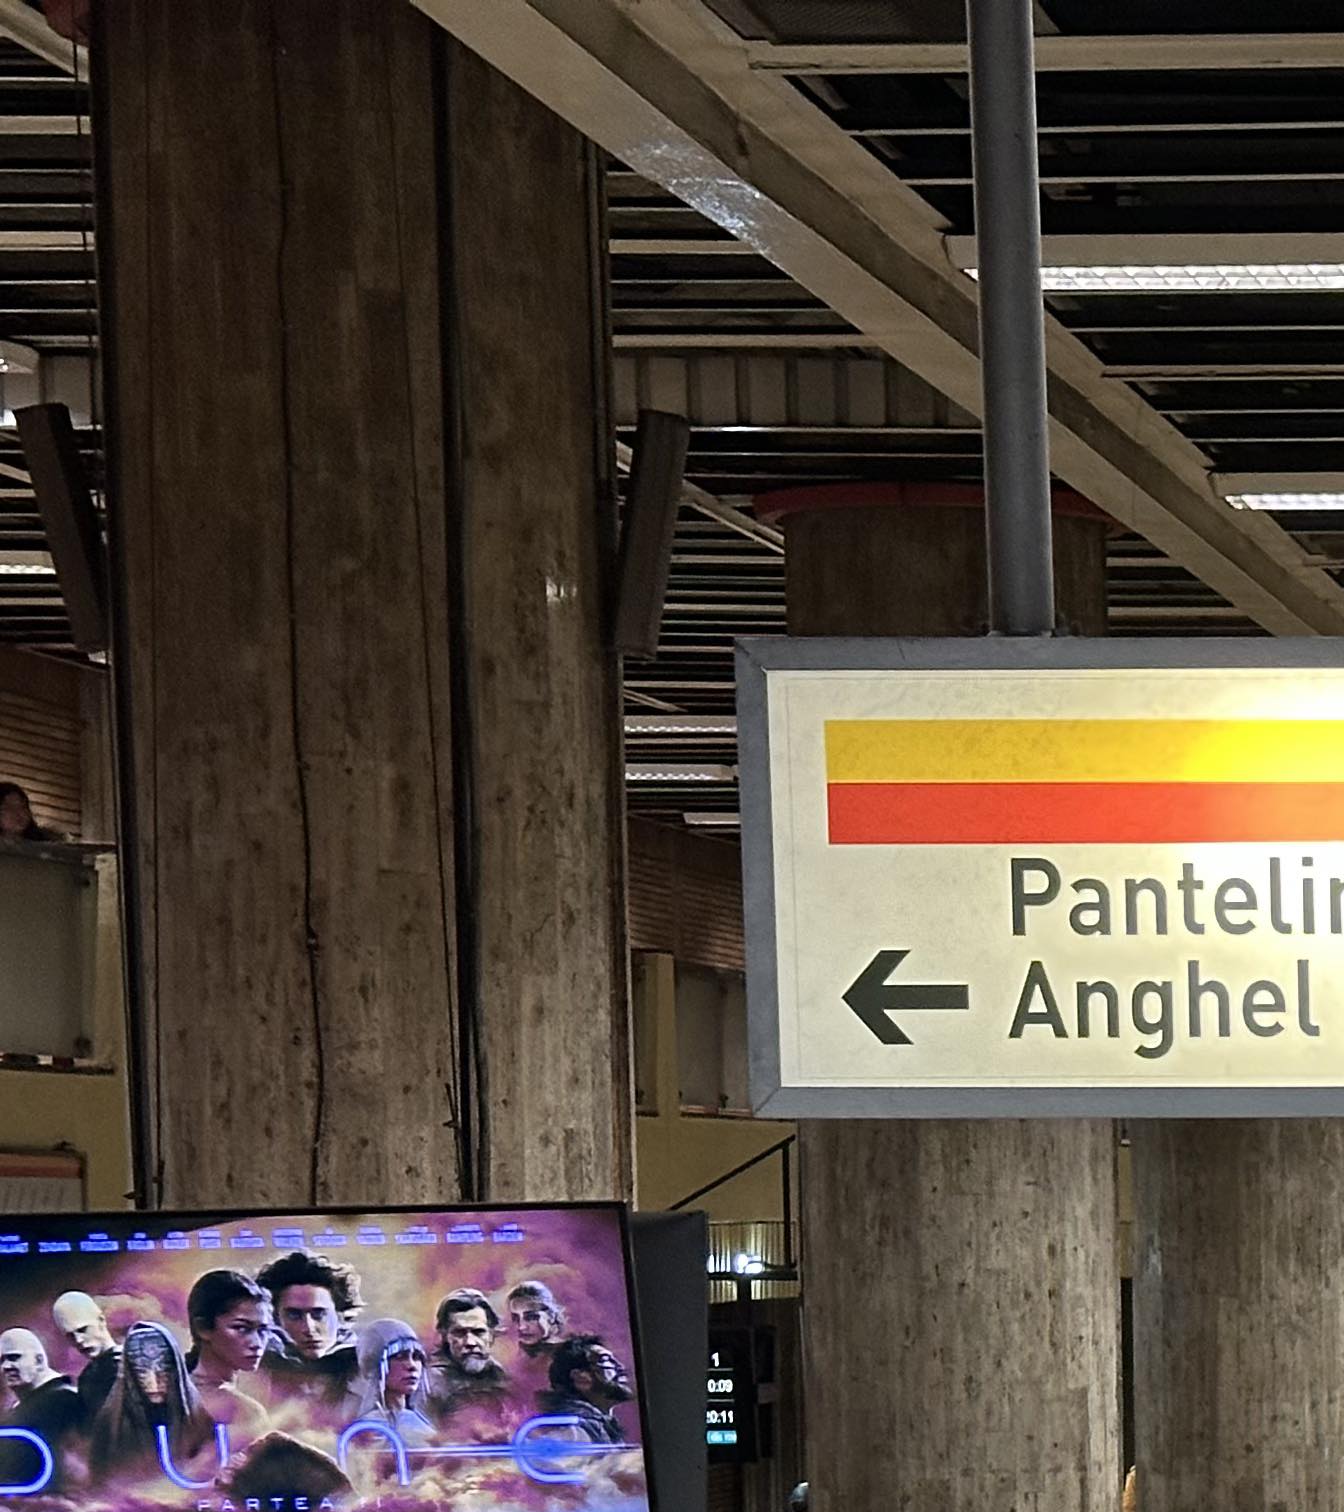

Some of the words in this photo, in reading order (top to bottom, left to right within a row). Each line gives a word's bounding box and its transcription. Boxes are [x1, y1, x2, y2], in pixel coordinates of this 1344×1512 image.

[1008, 959, 1320, 1059] Anghel
[0, 1415, 588, 1497] DUNE
[197, 1497, 335, 1512] PARTEA
